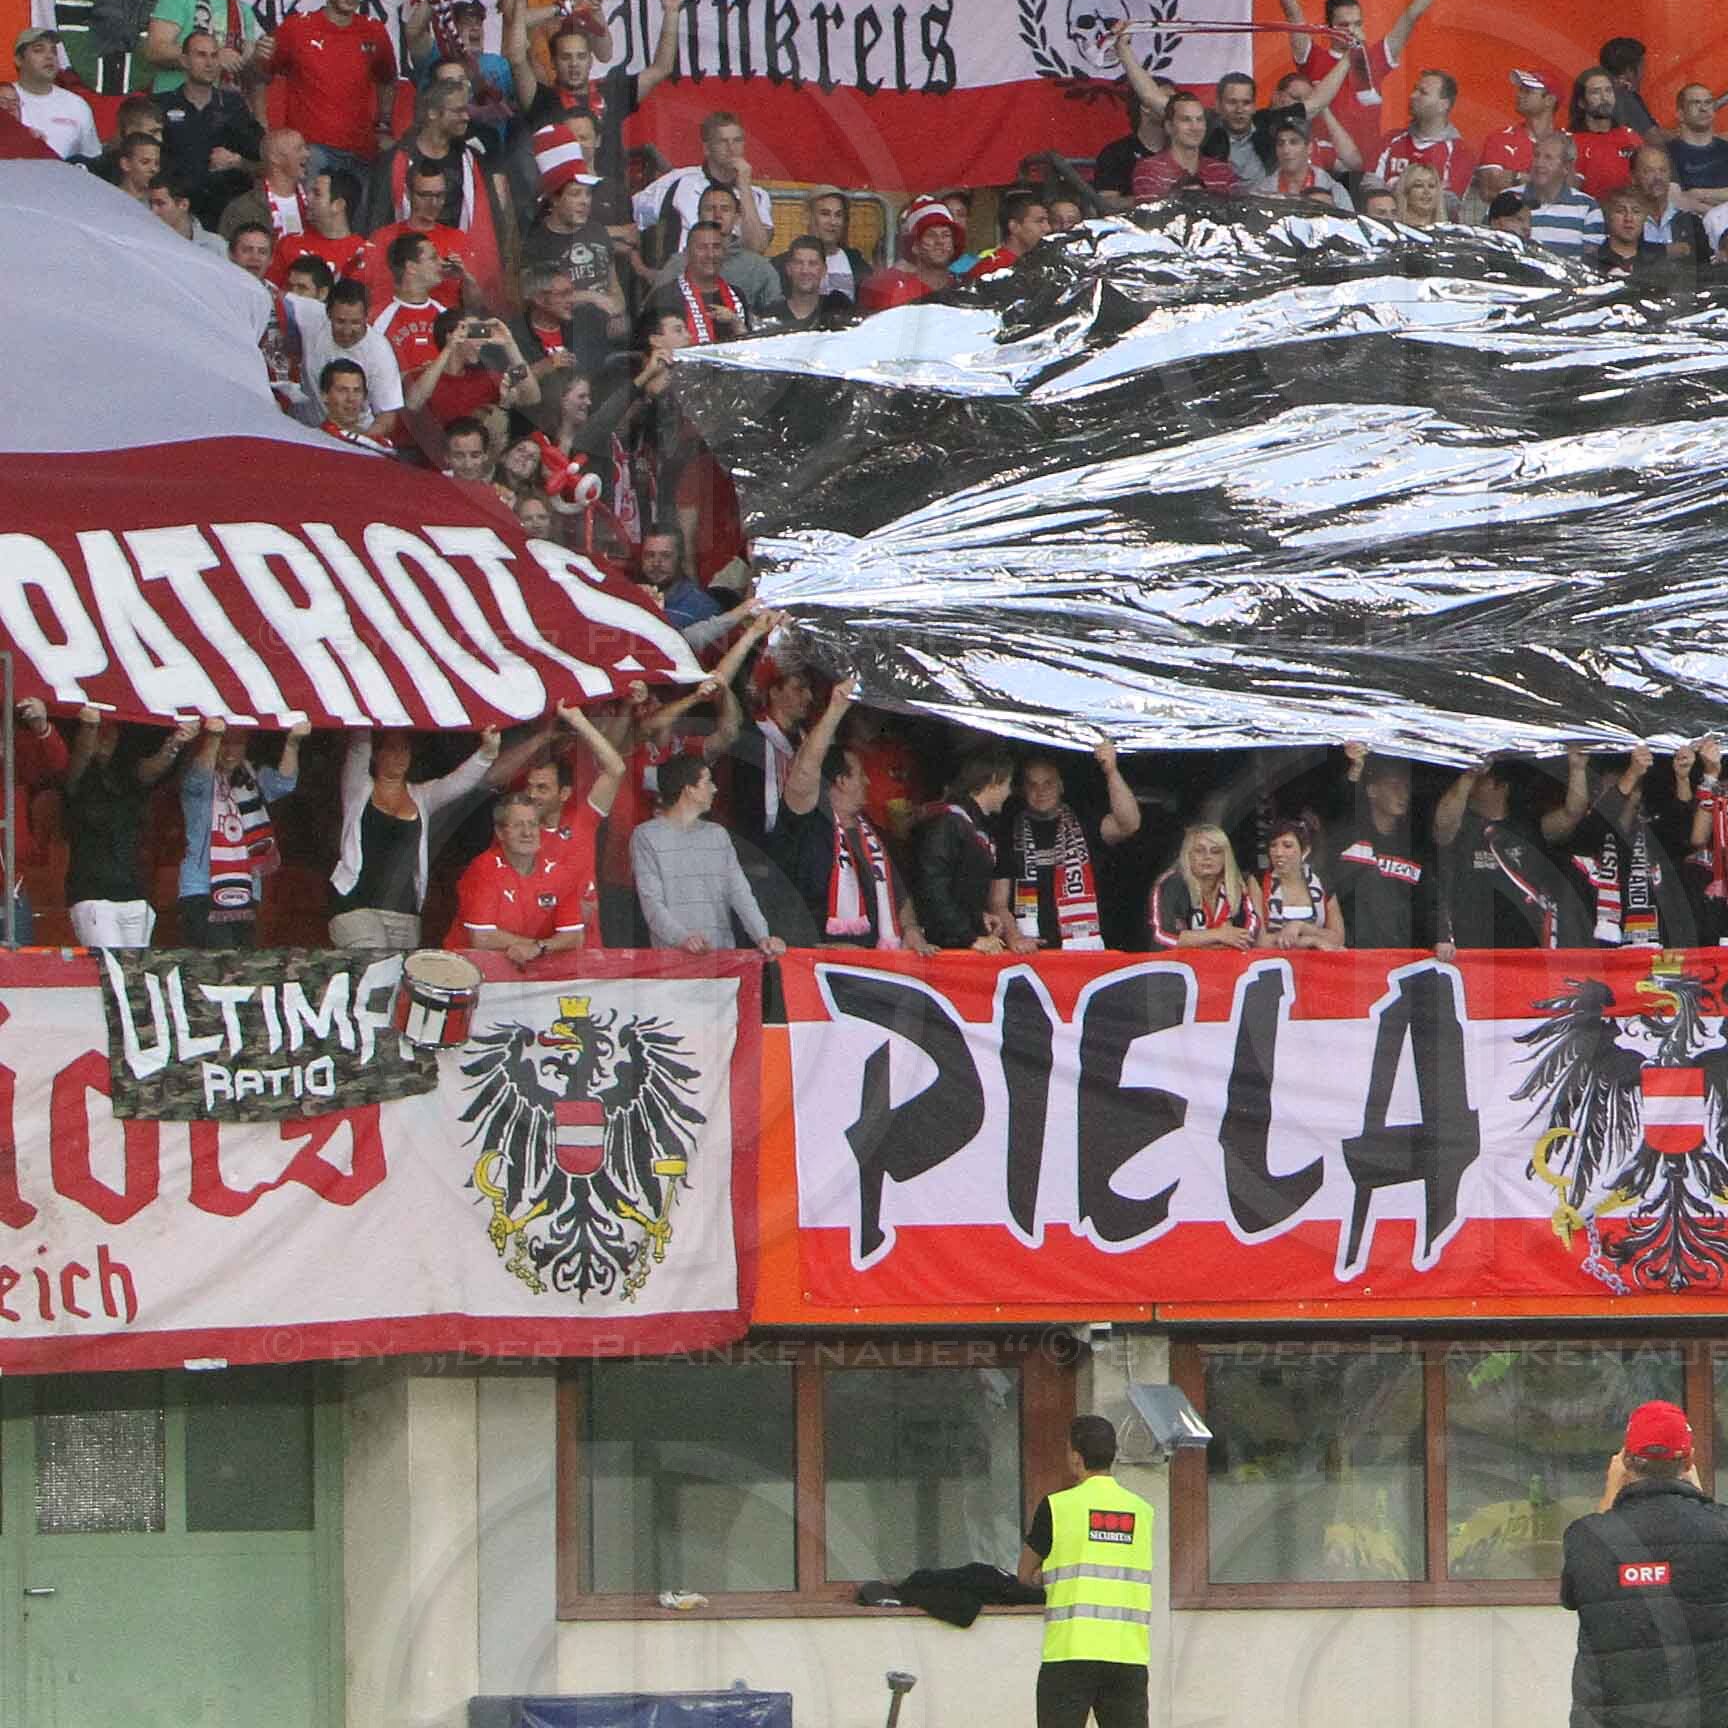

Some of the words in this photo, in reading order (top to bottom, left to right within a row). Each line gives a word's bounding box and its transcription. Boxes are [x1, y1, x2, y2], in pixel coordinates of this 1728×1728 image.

[204, 1056, 337, 1112] RATIO
[815, 959, 1482, 1282] PIELA
[1624, 1565, 1668, 1582] ORF
